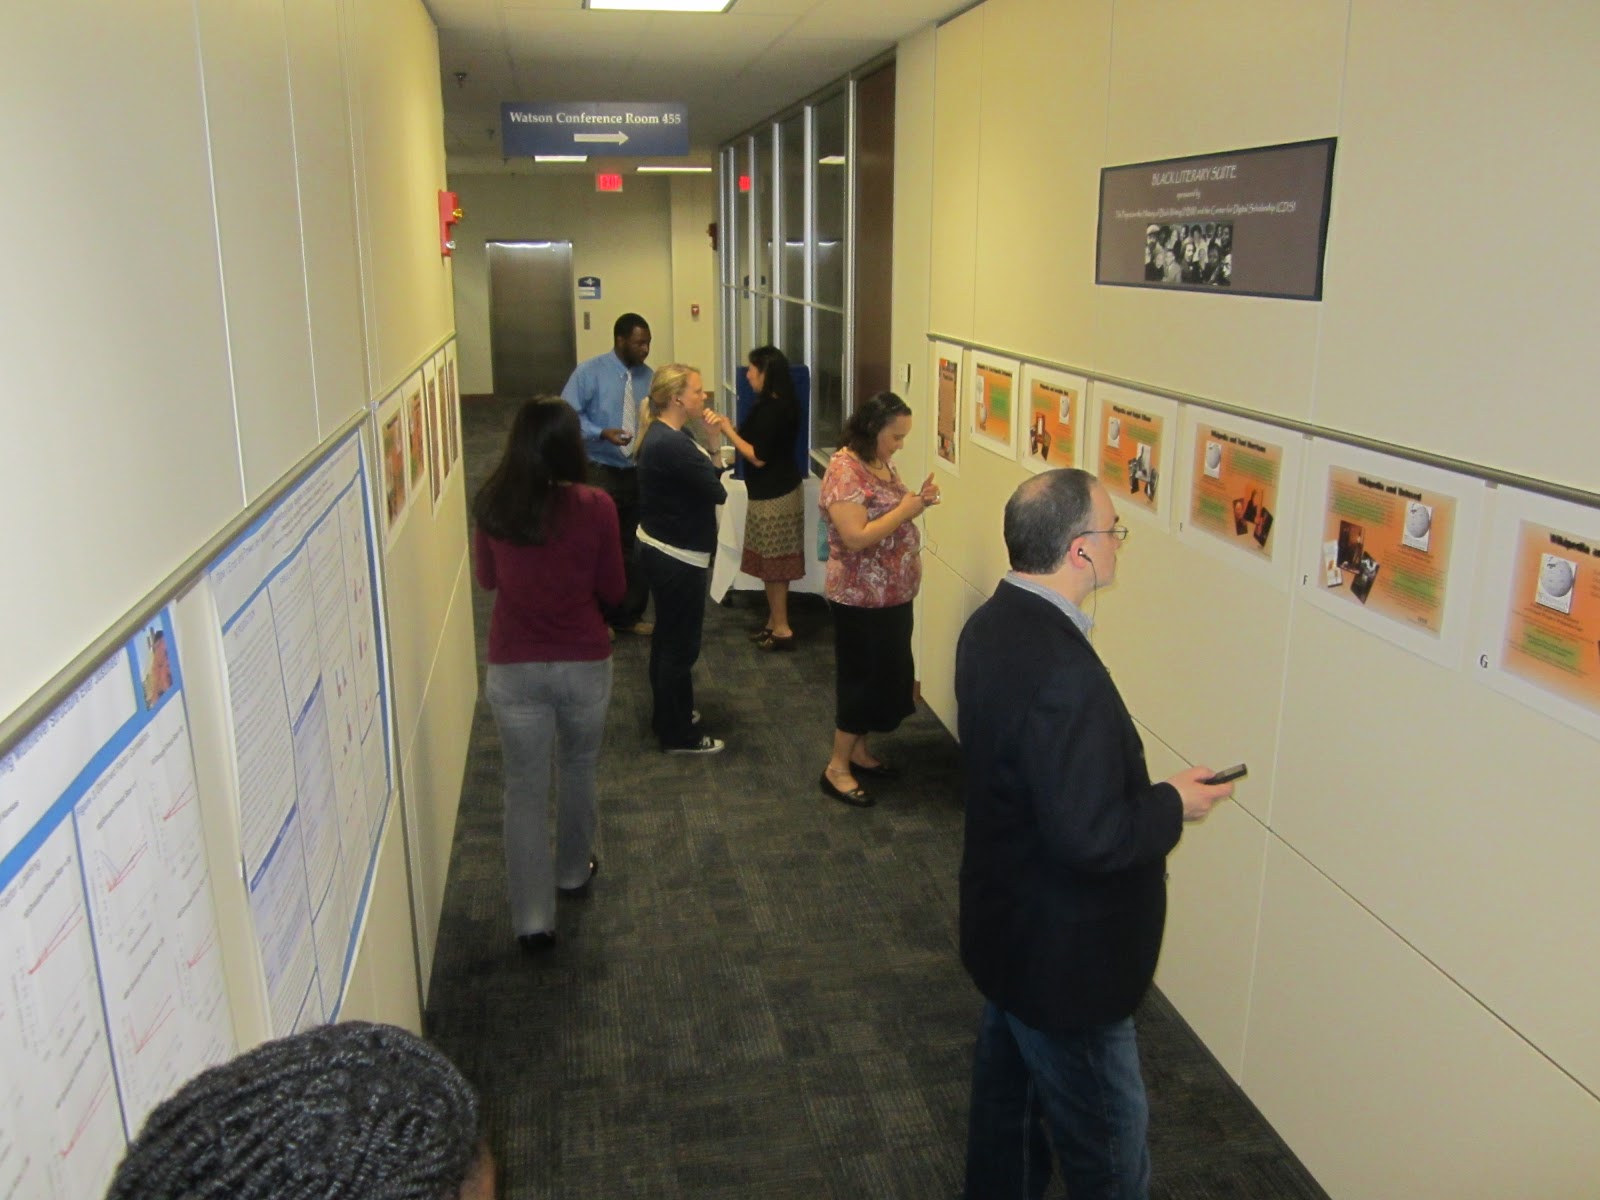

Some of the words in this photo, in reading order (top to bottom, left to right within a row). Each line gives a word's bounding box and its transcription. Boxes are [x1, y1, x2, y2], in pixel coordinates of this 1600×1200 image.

[509, 111, 553, 124] Watson
[556, 112, 623, 124] Conference
[625, 113, 660, 124] Room
[661, 113, 682, 125] 455
[600, 175, 620, 190] EXIT
[1152, 171, 1175, 187] BLACK
[1175, 167, 1211, 184] LITERARY
[1210, 164, 1237, 181] SUITE
[1550, 533, 1590, 555] Wikipedia
[1479, 653, 1488, 669] G
